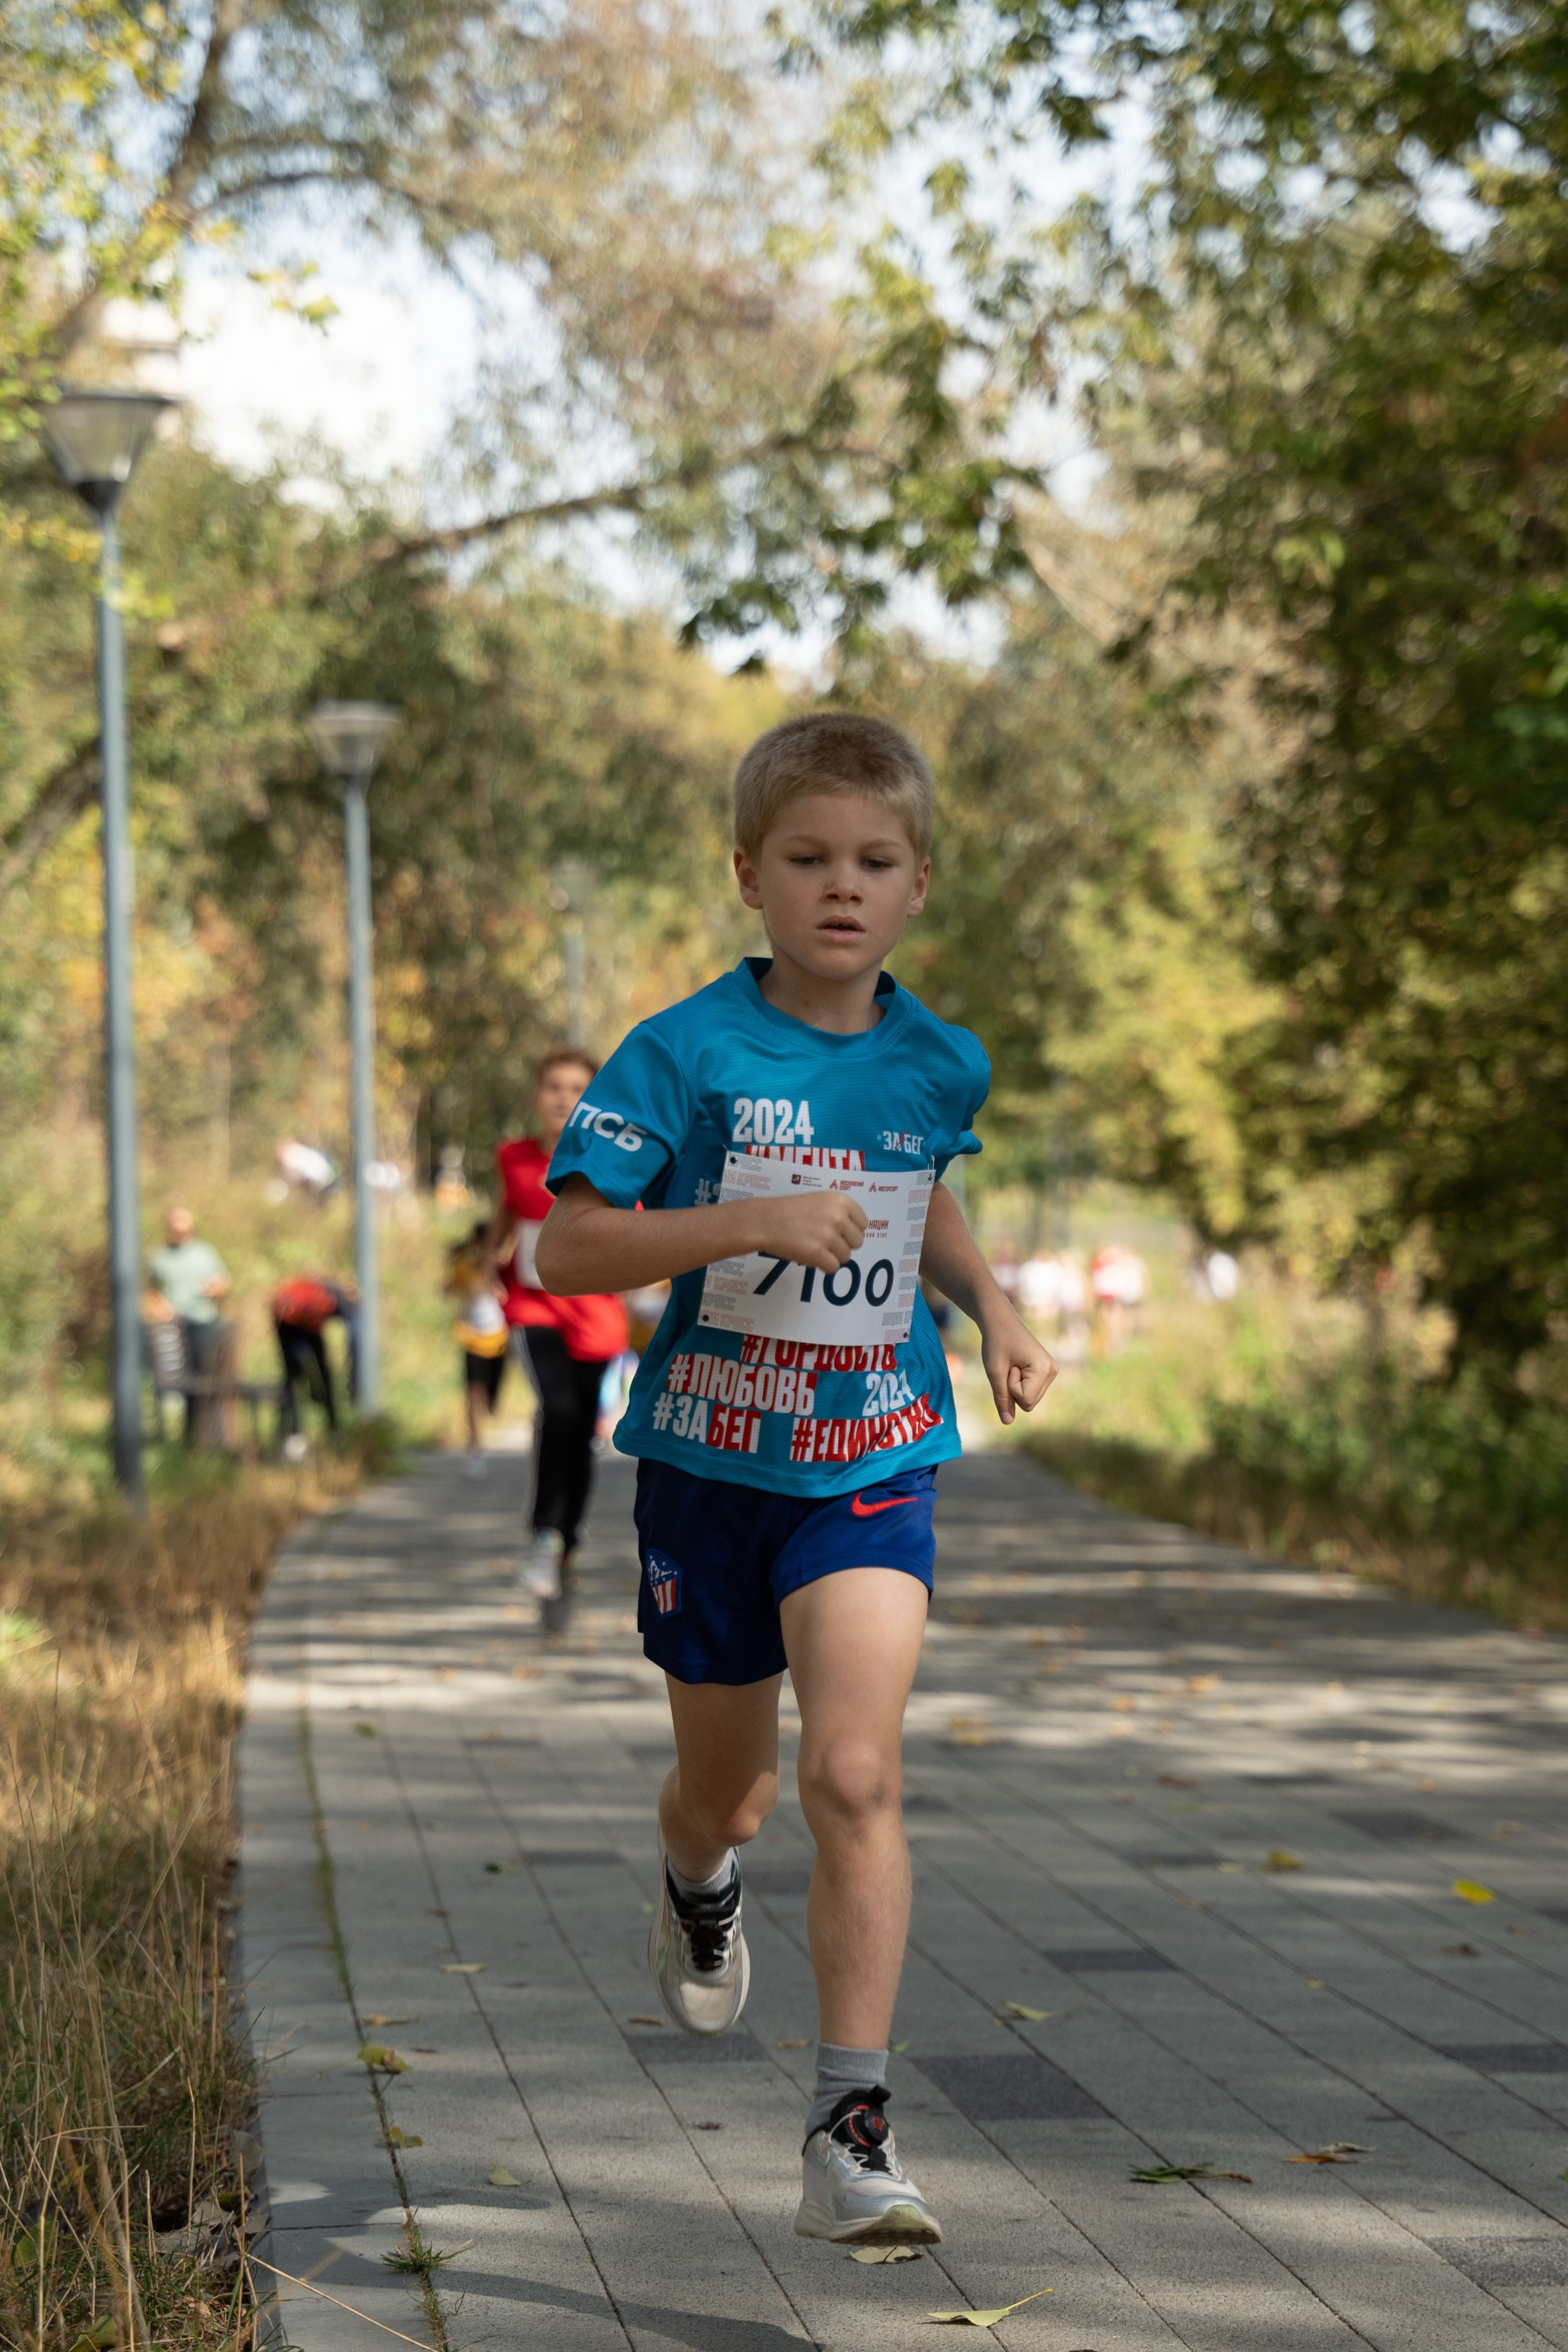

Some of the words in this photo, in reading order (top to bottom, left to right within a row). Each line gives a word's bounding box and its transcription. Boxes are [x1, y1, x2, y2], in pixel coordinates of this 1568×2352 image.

[569, 1102, 648, 1152] ПСБ
[732, 1098, 815, 1145] 2024
[737, 1172, 771, 1191] КРОСС
[868, 1220, 890, 1231] НАЦИИ
[714, 1276, 749, 1295] КРОСС
[753, 1250, 895, 1308] 7100
[720, 1313, 755, 1333] КРОСС
[667, 1353, 817, 1416] #ЛЮБОВЬ
[862, 1368, 916, 1417] 2024
[652, 1392, 762, 1454] #ЗАБЕГ
[790, 1393, 945, 1462] #ЕДИНСТВО
